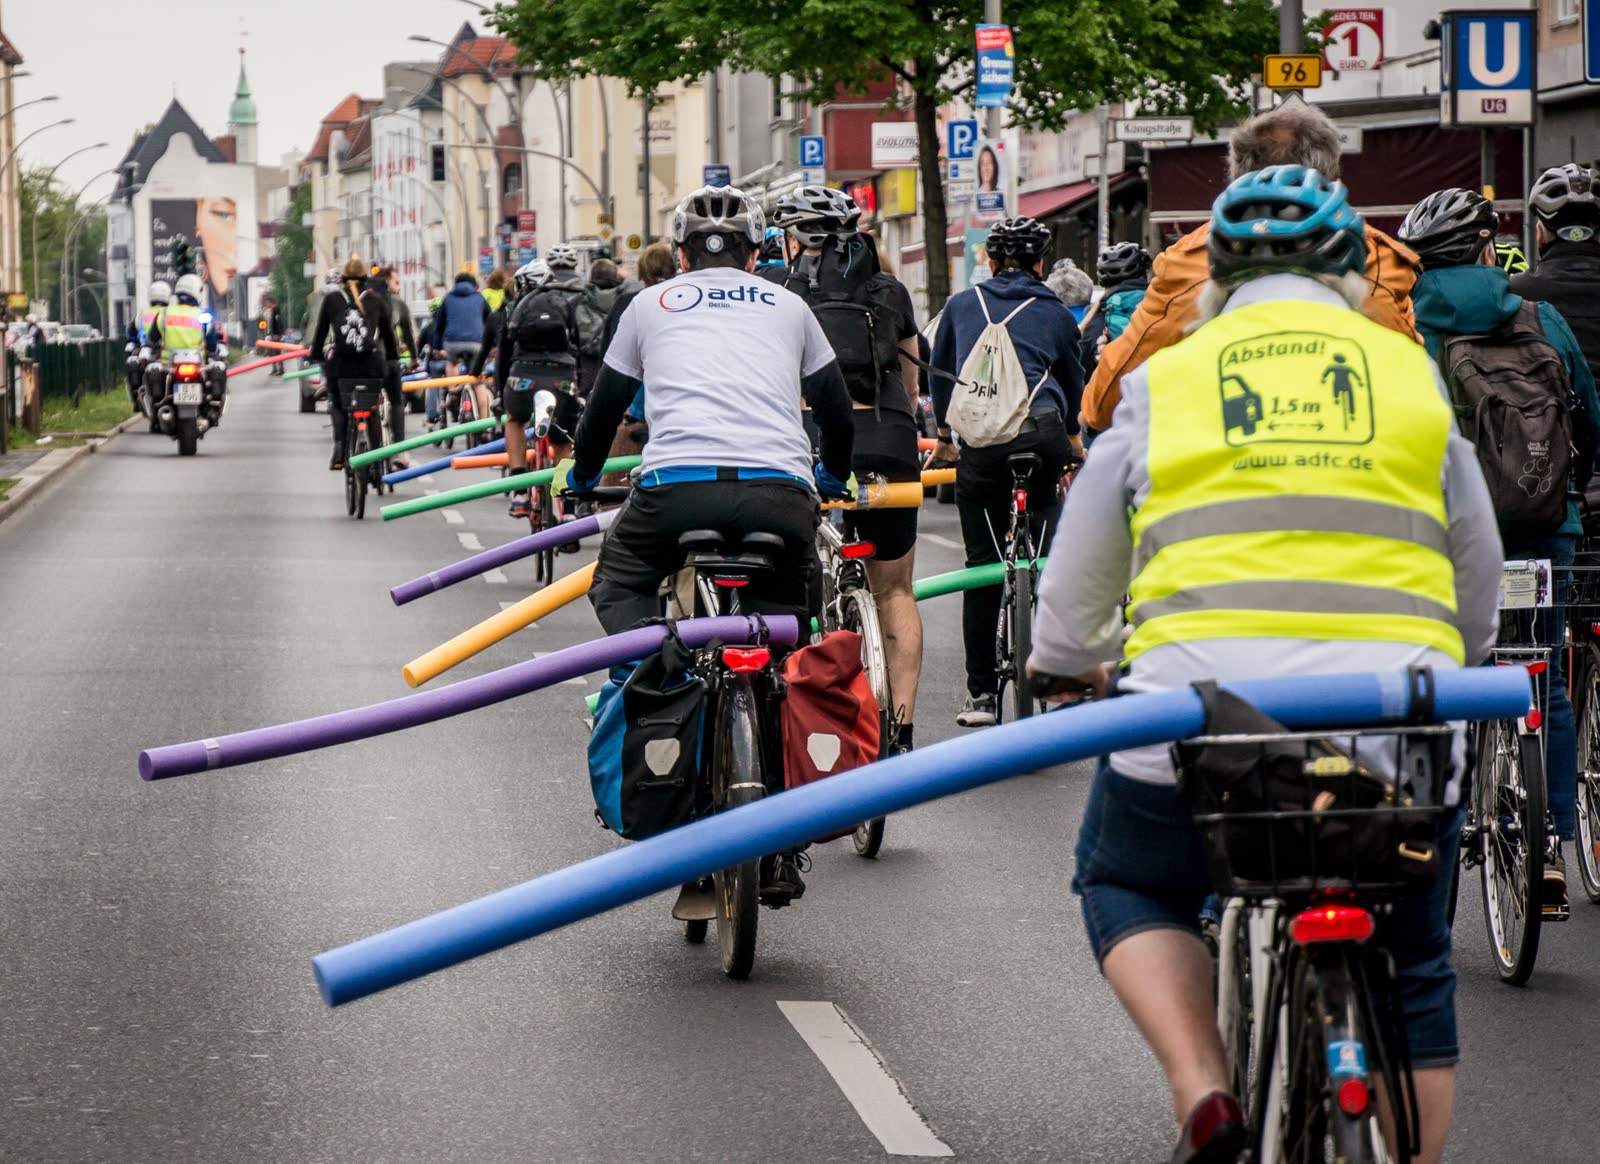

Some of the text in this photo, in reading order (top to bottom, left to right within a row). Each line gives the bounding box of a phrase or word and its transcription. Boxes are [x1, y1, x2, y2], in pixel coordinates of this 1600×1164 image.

[1359, 12, 1376, 20] TEIL
[1342, 26, 1358, 57] 1
[1469, 21, 1520, 87] U
[1280, 62, 1306, 82] 96
[1339, 60, 1367, 69] EURO
[1484, 101, 1505, 112] U6
[1124, 122, 1182, 135] Königstraße
[953, 125, 972, 155] P
[805, 140, 819, 163] P
[708, 286, 775, 306] adfc
[1225, 339, 1325, 368] Abstand!
[1270, 396, 1320, 415] 1,5 m
[1232, 454, 1373, 470] www.adfc.de
